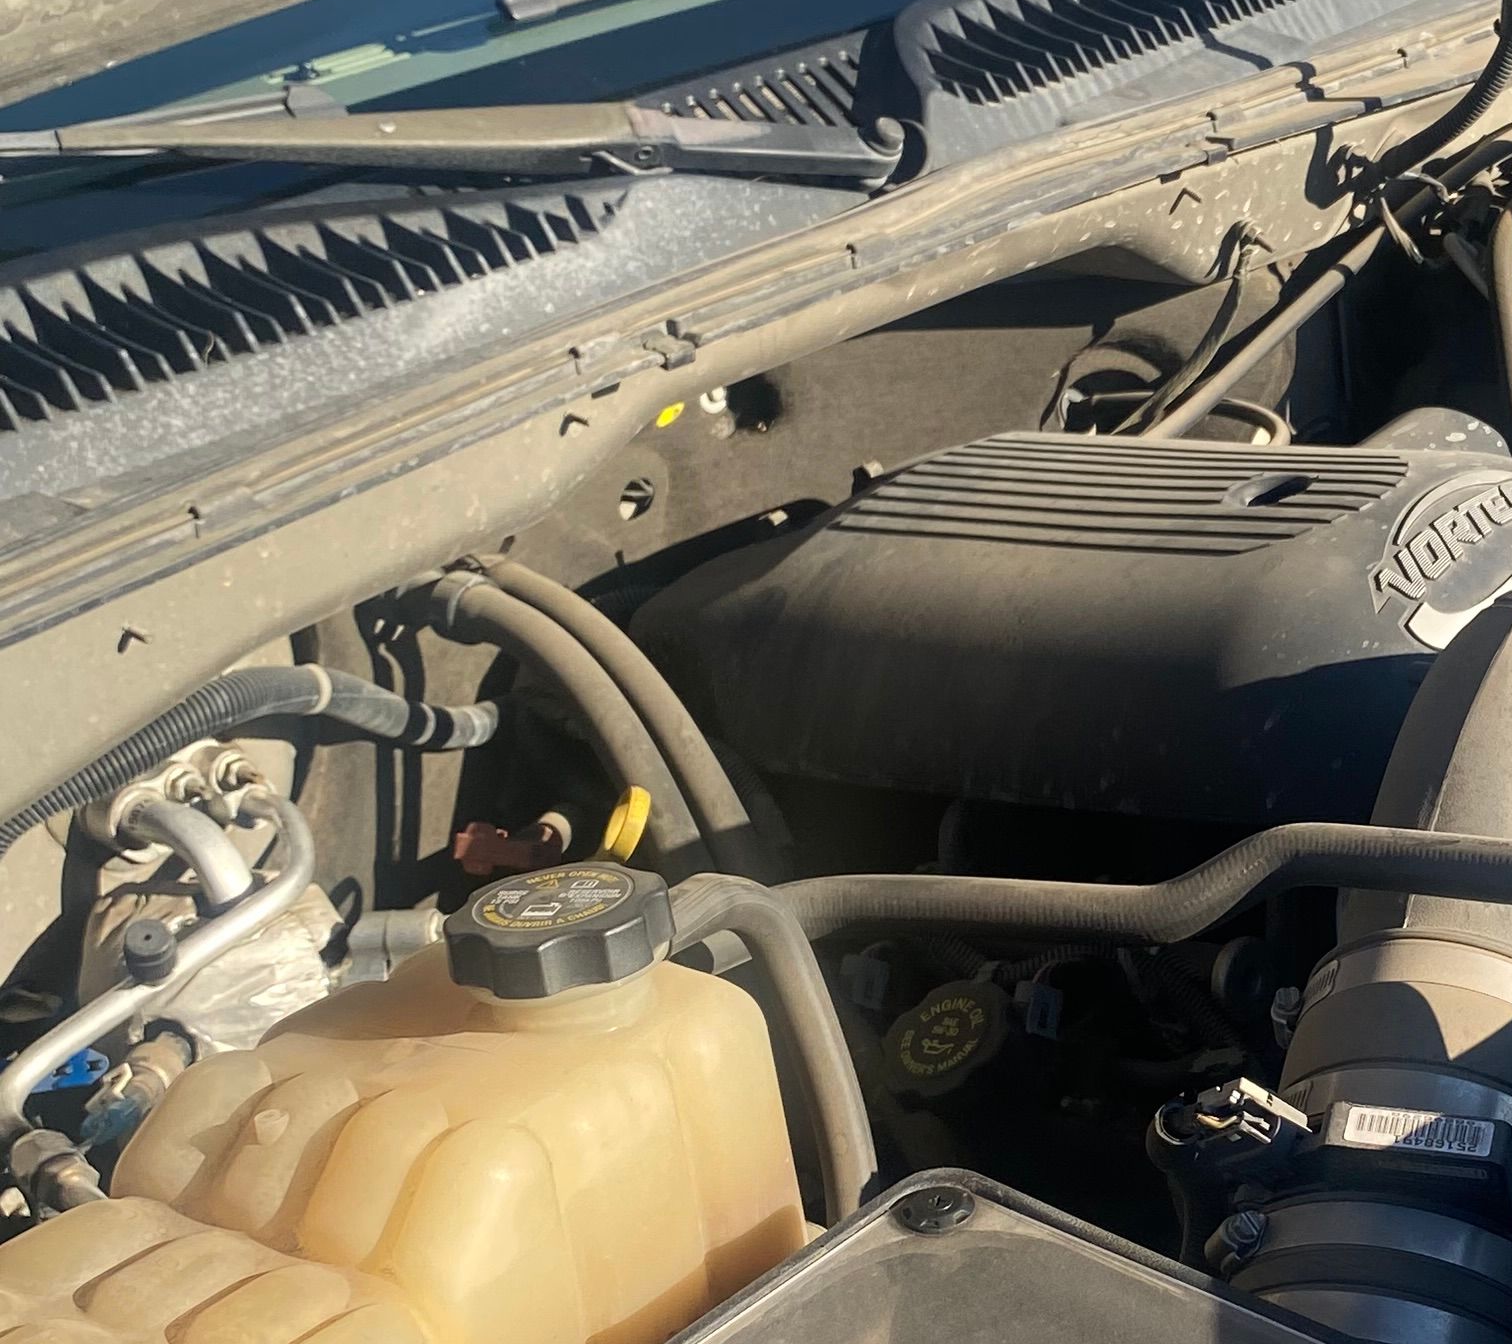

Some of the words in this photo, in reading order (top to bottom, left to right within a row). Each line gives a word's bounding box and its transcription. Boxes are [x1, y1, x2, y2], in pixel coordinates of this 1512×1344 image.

[526, 871, 566, 884] NEVER
[920, 997, 977, 1023] ENGINE
[969, 1007, 985, 1030] OIL
